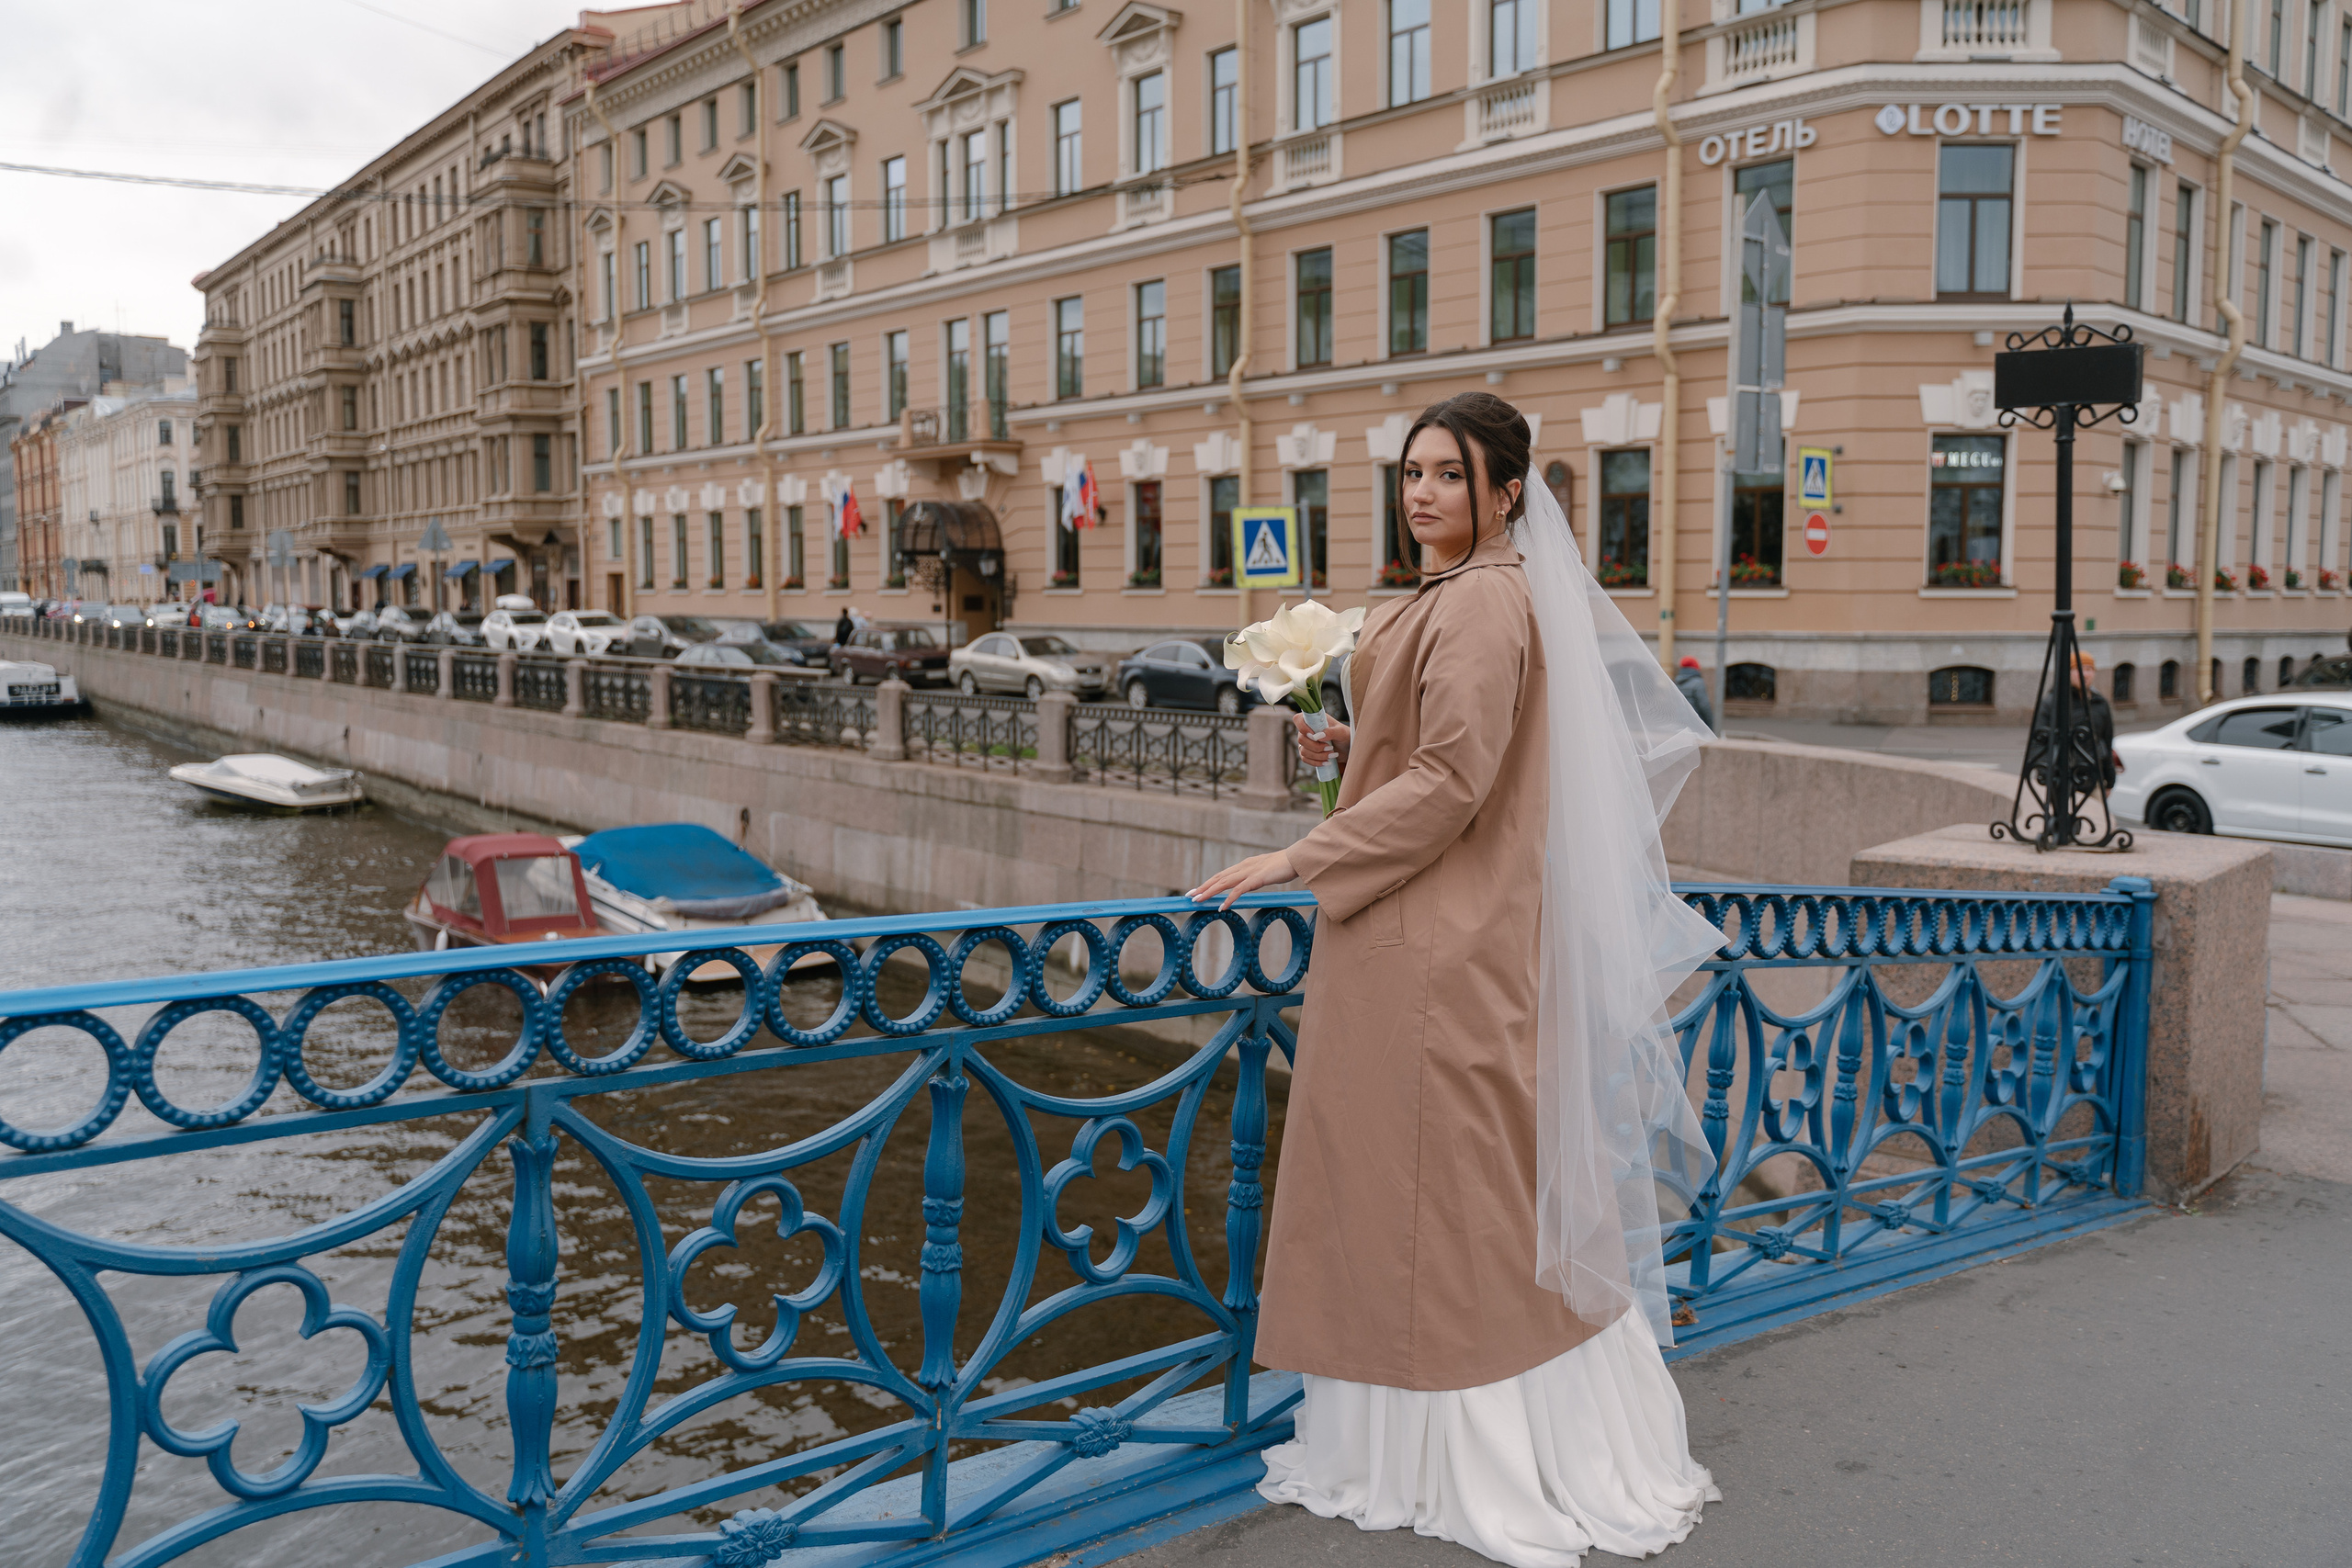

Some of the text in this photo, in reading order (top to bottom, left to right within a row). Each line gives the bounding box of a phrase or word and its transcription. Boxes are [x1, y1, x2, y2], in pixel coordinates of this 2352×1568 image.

[1698, 118, 1816, 165] ОТЕЛЬ
[1907, 103, 2063, 136] LOTTE
[2121, 116, 2176, 165] HOTEL
